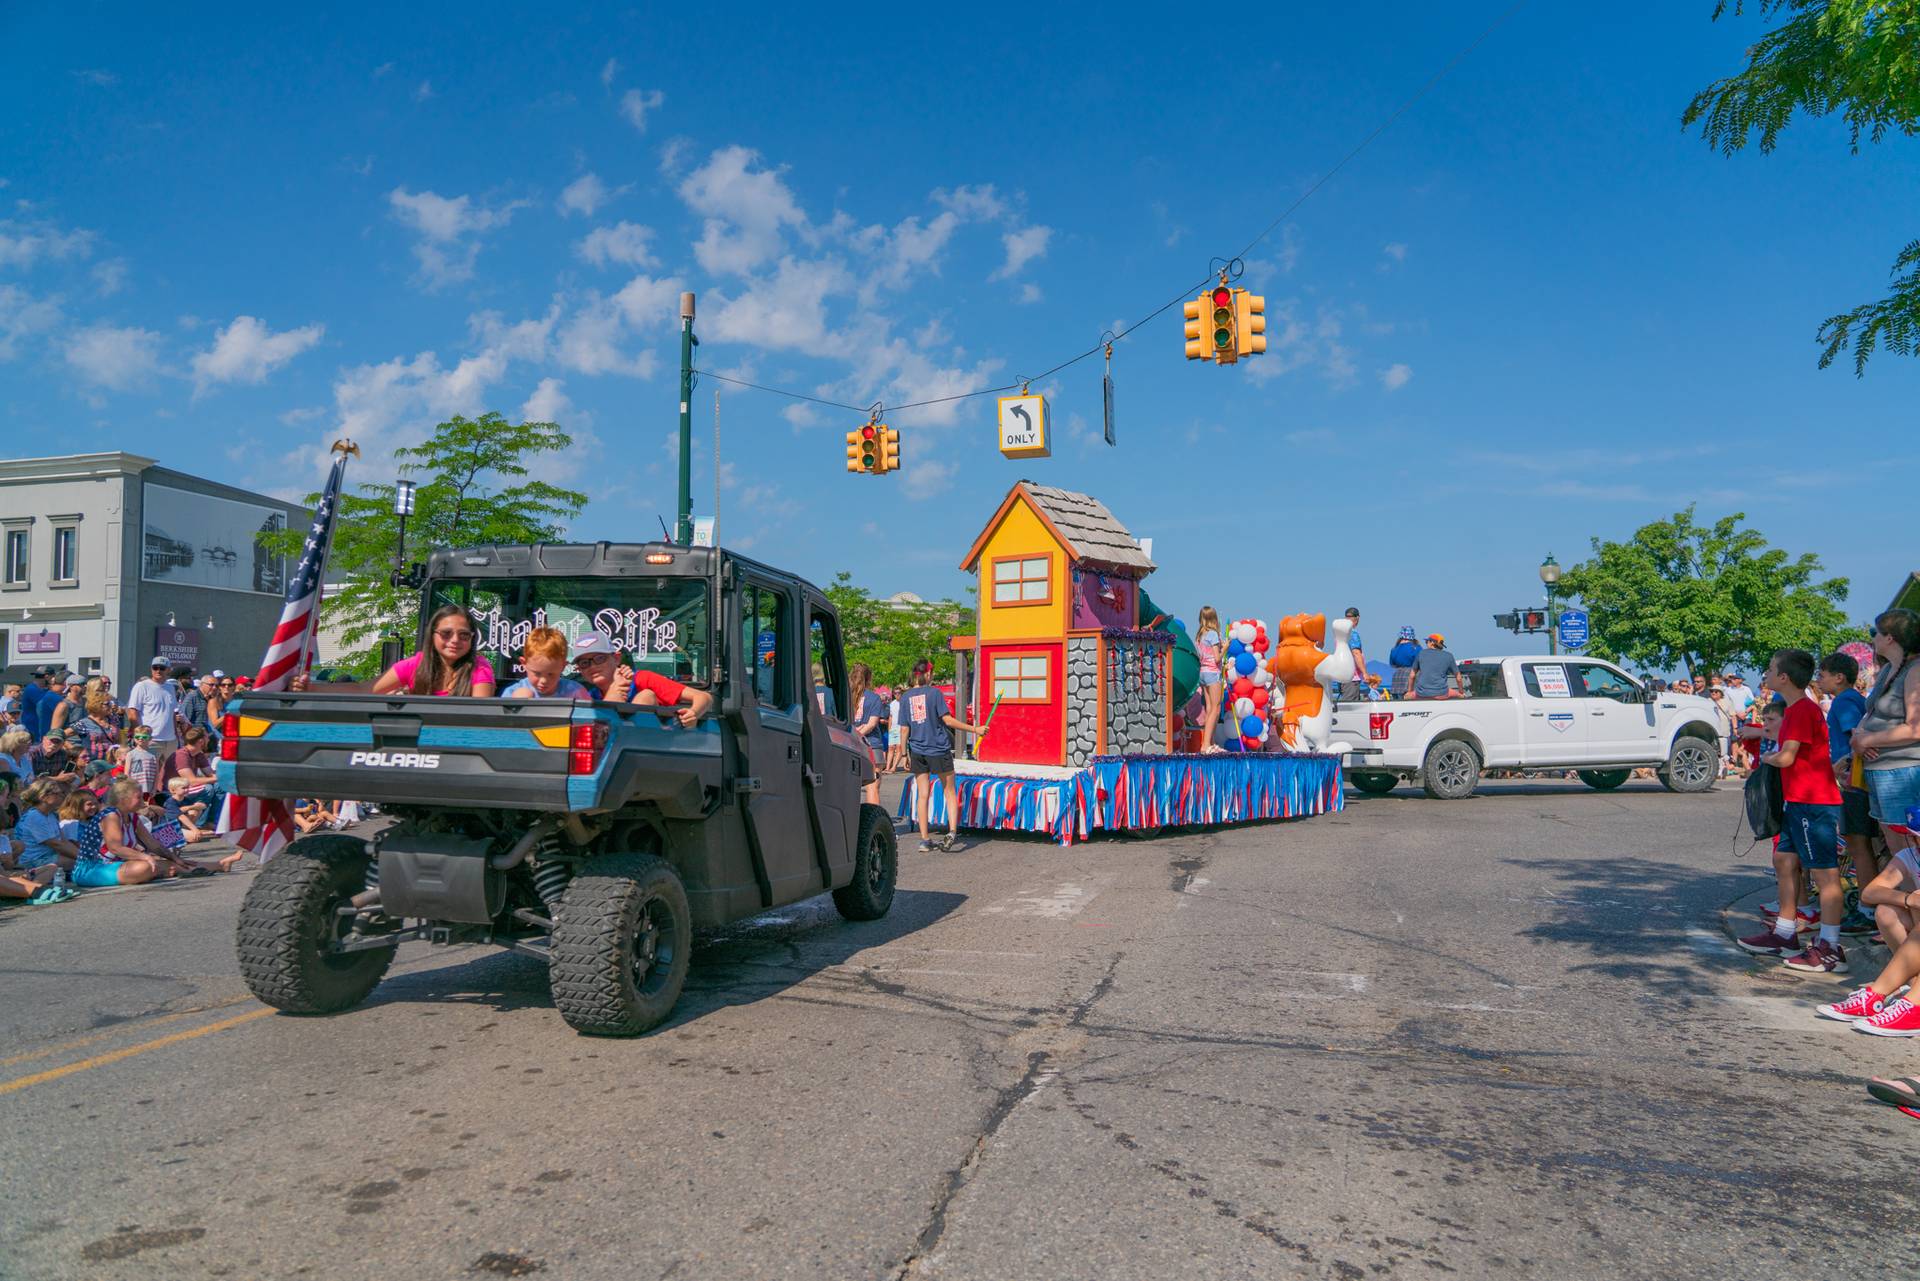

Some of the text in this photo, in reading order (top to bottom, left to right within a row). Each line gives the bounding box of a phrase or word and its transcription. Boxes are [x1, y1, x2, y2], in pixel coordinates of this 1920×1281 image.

[1007, 433, 1035, 445] ONLY
[594, 607, 677, 661] Life
[160, 645, 199, 654] BERKSHIRE
[161, 652, 197, 661] HATHAWAY
[350, 751, 440, 769] POLARIS
